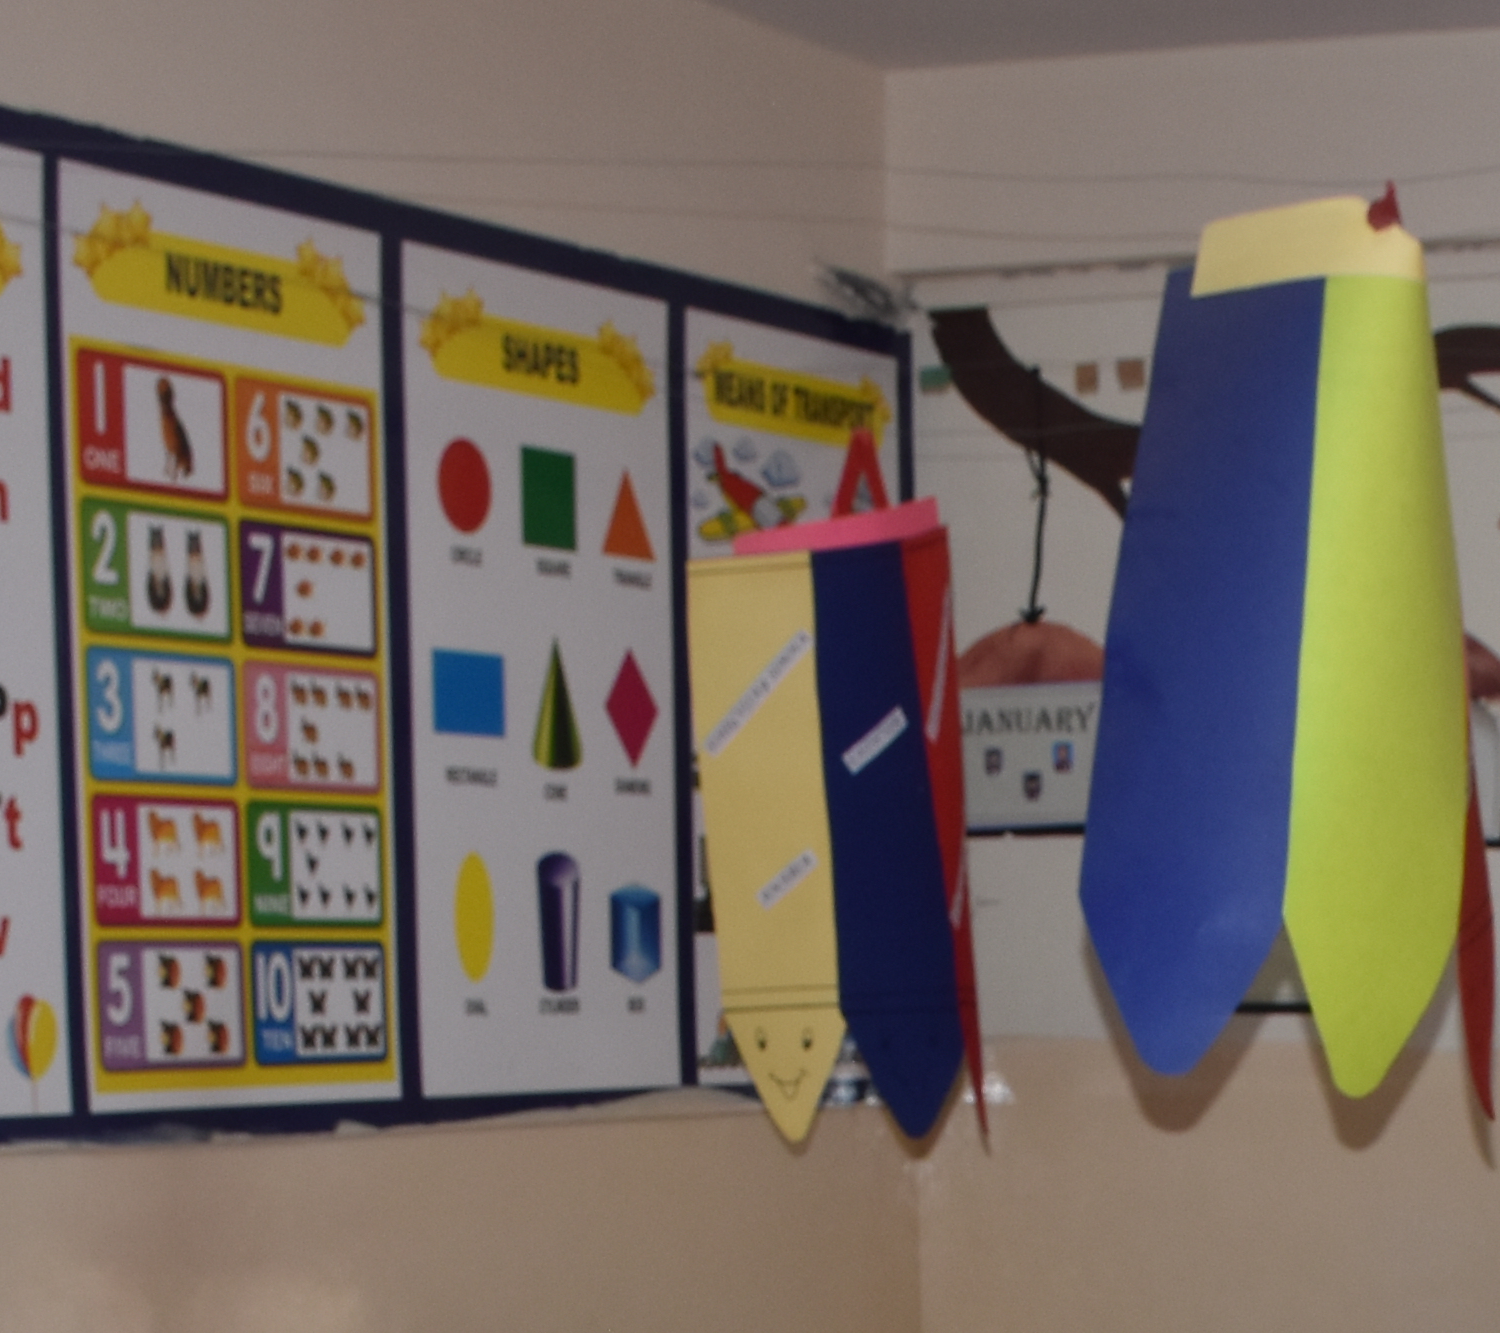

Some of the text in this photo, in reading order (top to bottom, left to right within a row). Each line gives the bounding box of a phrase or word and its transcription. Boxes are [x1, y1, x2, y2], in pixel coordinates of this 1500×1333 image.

[165, 251, 283, 316] NUMBERS
[502, 333, 580, 386] SHAPES
[245, 391, 271, 462] 6
[92, 509, 119, 586] 2
[247, 532, 275, 603] 7
[96, 659, 124, 732] 3
[253, 673, 279, 744] 8
[962, 702, 1096, 735] JANUARY
[101, 808, 130, 879] 4
[256, 811, 283, 882] 9
[106, 952, 134, 1027] 5
[255, 951, 292, 1022] 10
